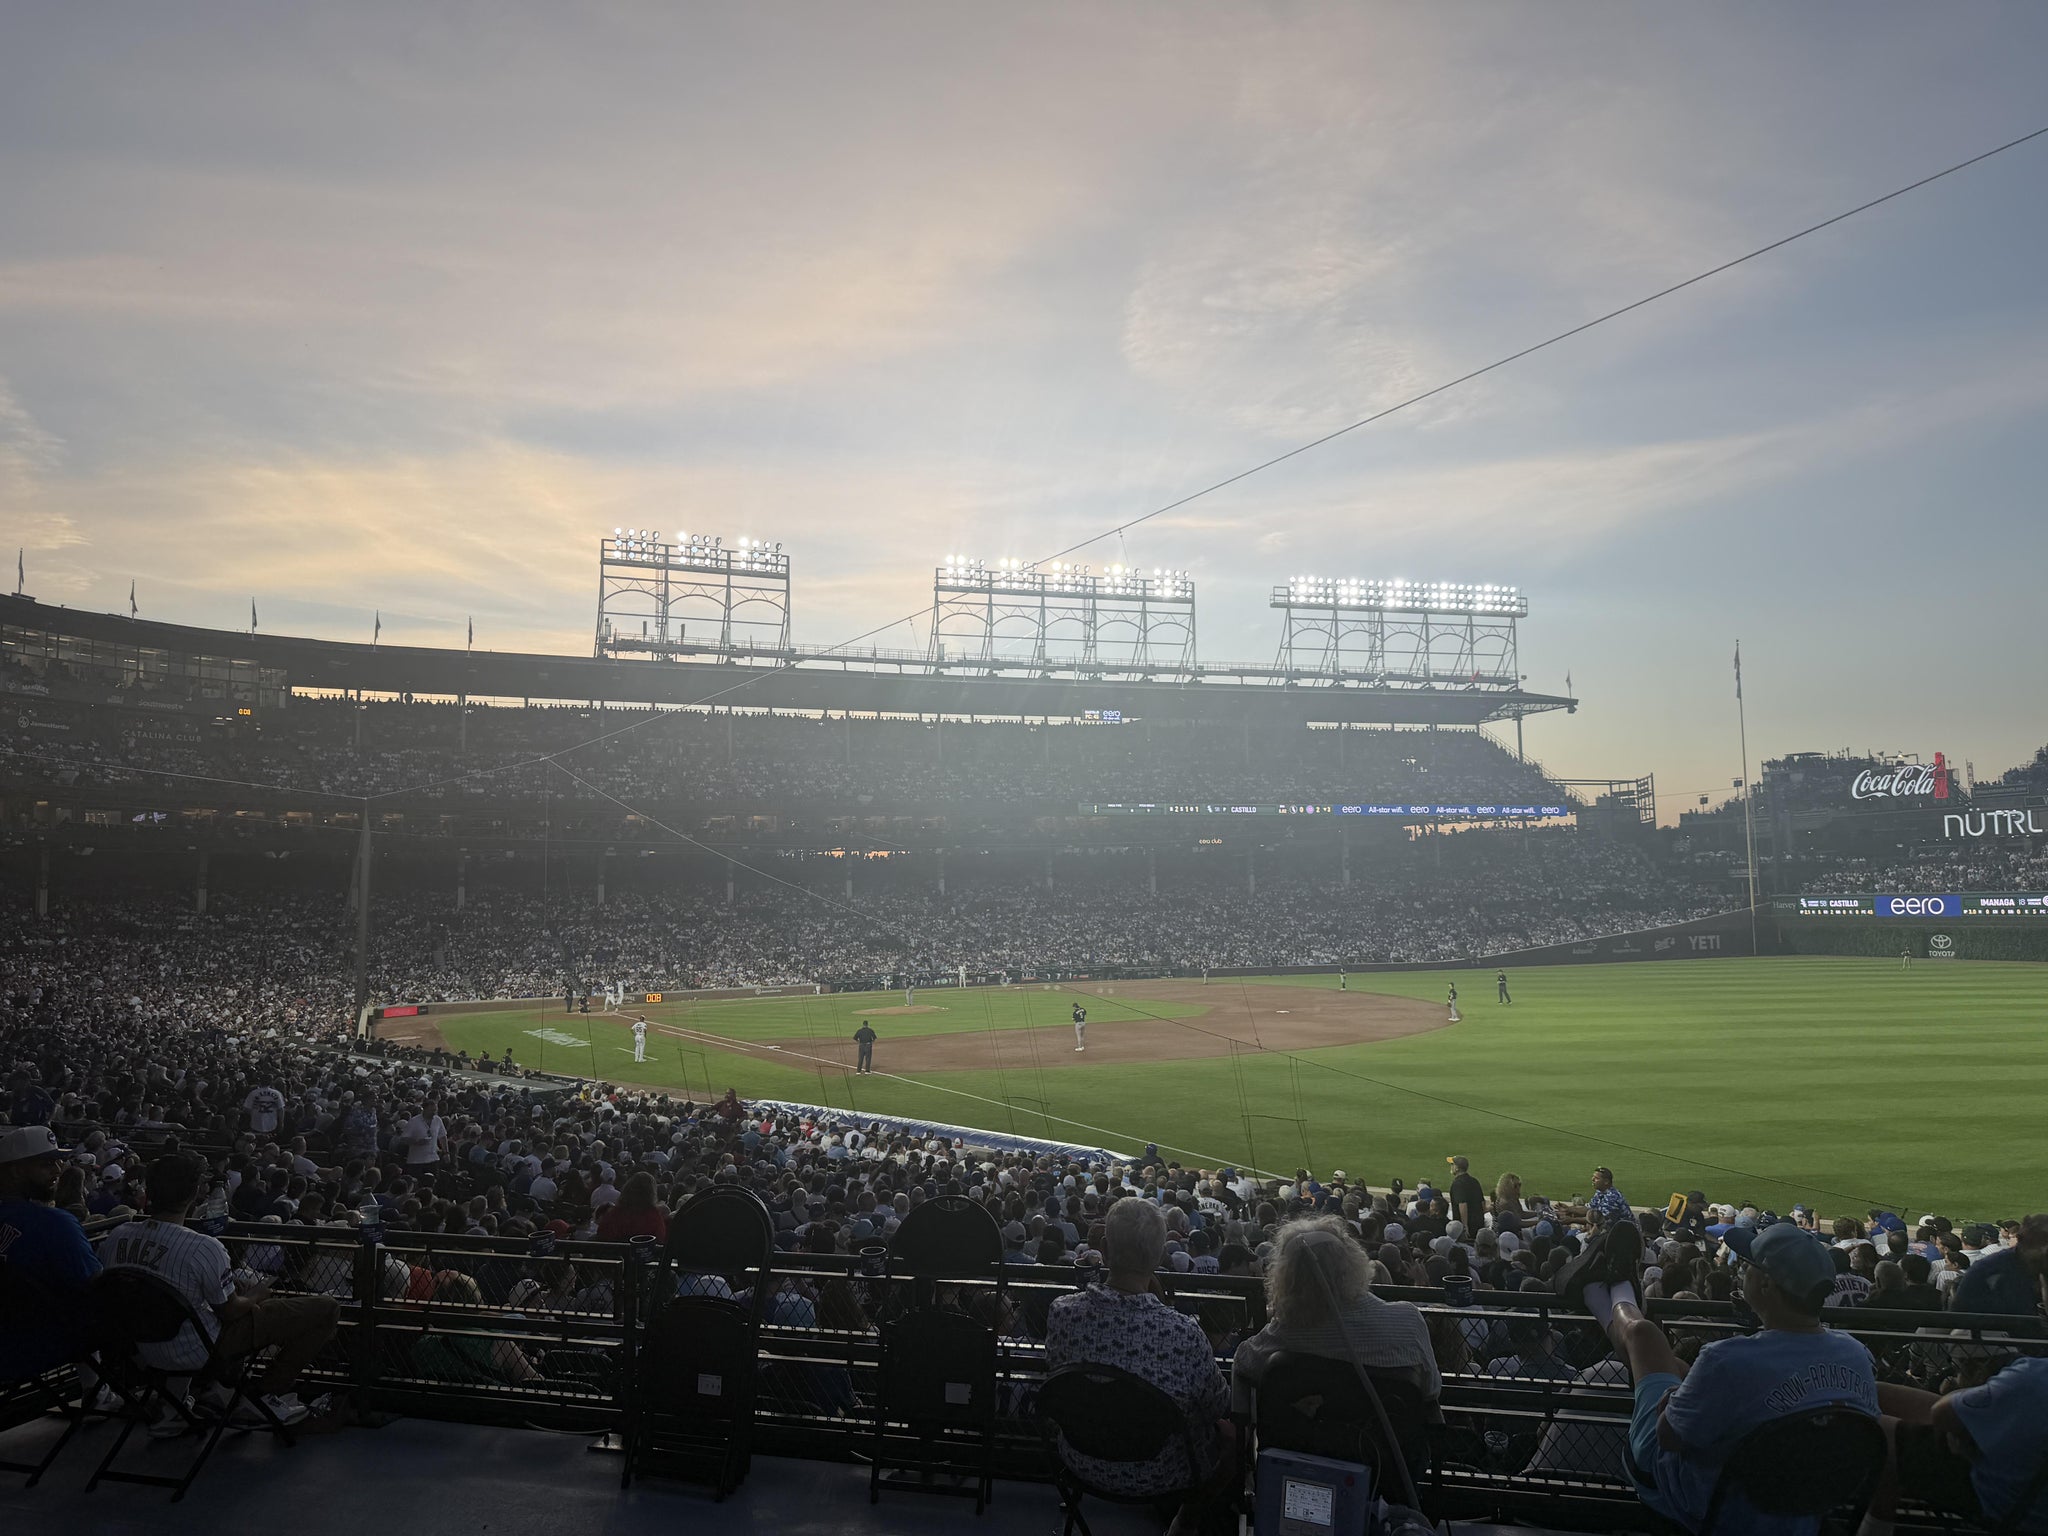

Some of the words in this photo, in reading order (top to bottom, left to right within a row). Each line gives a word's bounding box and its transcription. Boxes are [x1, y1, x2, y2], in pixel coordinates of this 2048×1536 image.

[121, 730, 172, 741] CATALINA
[175, 734, 202, 743] CLUB
[1851, 763, 1936, 800] Coca-Cola
[1341, 805, 1361, 814] eero
[1368, 806, 1391, 814] All-star
[1410, 805, 1430, 814] eero
[1436, 806, 1457, 814] All-star
[1477, 806, 1496, 814] eero
[1541, 806, 1560, 814] eero
[1829, 899, 1859, 908] CASTILLO
[1890, 897, 1945, 915] eero
[1980, 898, 2016, 907] IMANAGA
[1688, 935, 1720, 951] YETI
[1928, 950, 1956, 958] TOYOTA
[115, 1237, 169, 1270] BAEZ
